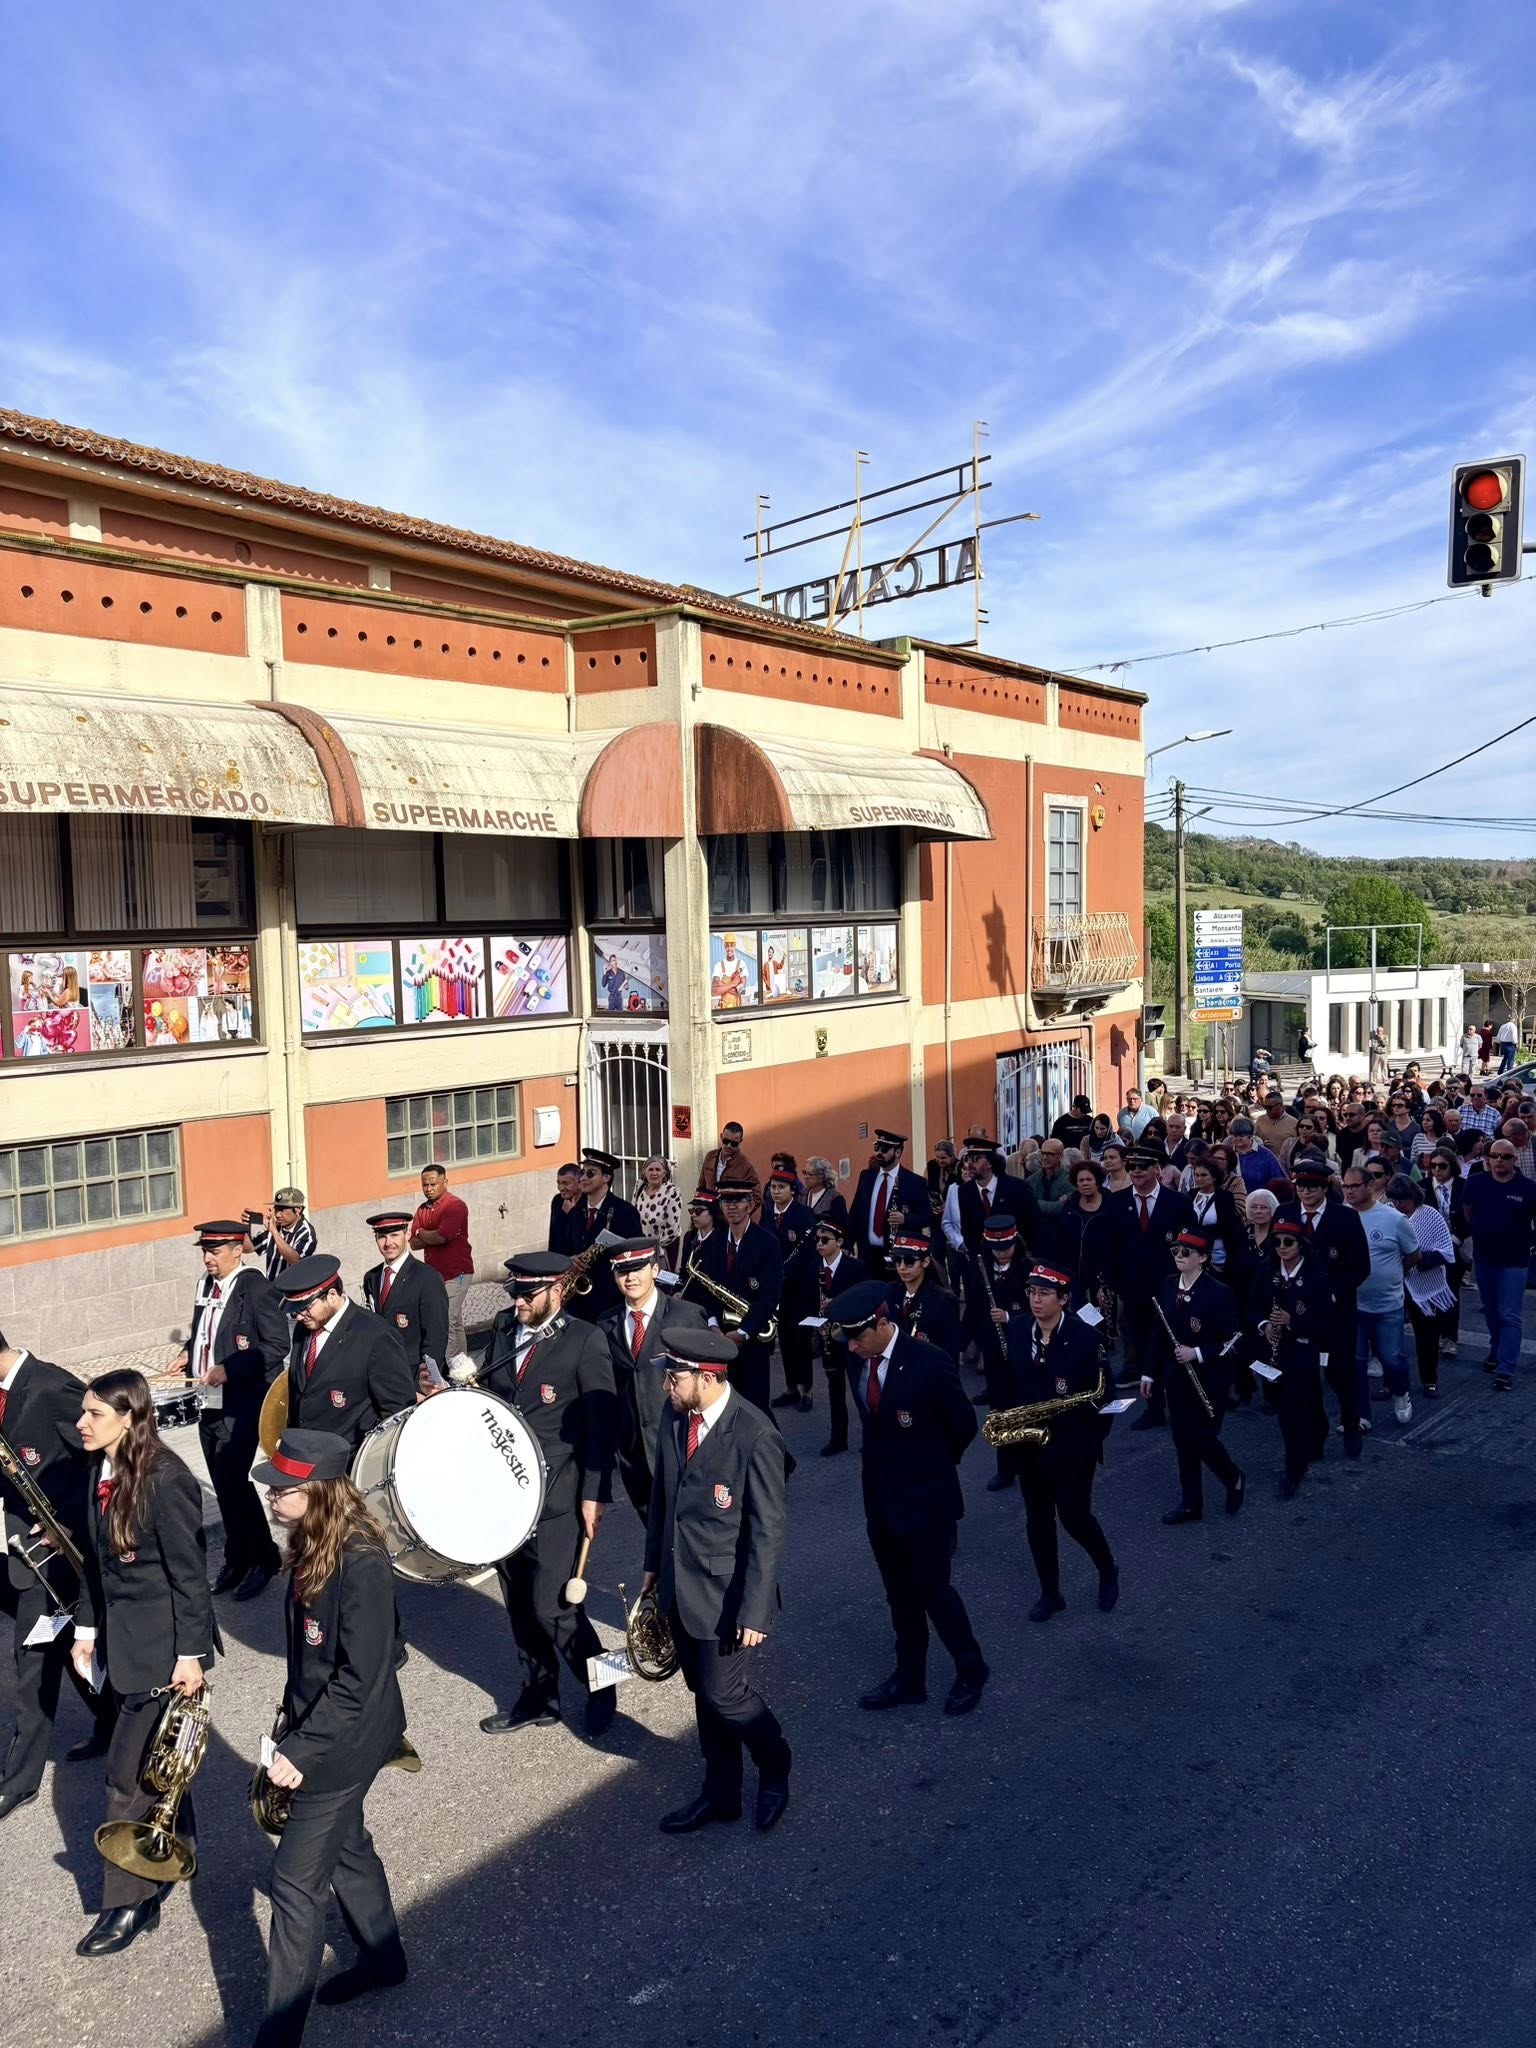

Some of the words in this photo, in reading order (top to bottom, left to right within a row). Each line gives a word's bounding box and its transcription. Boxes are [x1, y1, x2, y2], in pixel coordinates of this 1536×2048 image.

[374, 801, 559, 832] SUPERMARCHÉ
[849, 805, 956, 829] SUPERMERCADO
[1224, 961, 1241, 969] Porto
